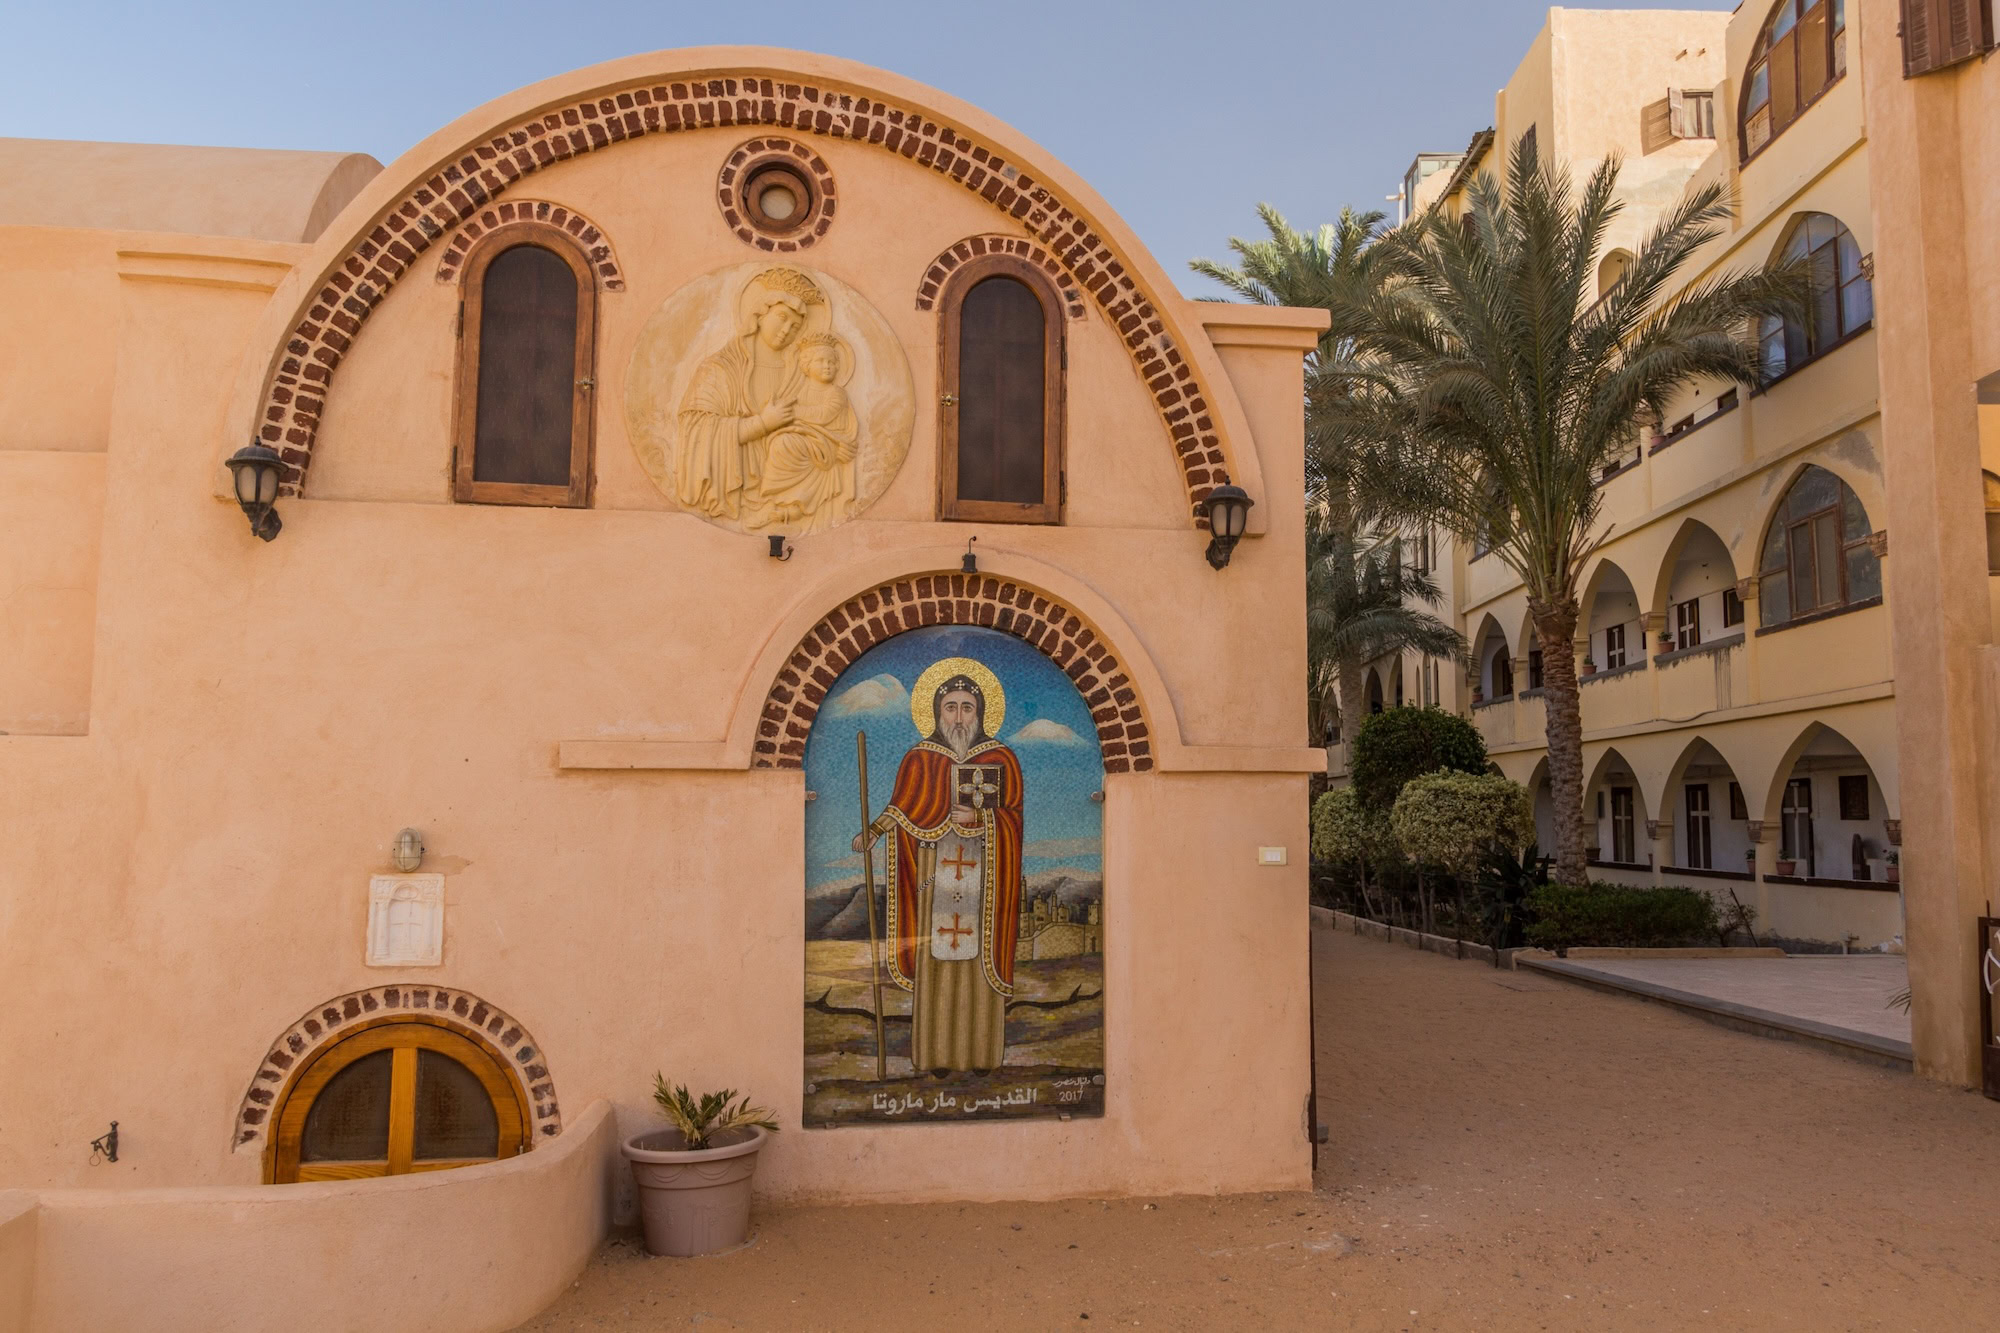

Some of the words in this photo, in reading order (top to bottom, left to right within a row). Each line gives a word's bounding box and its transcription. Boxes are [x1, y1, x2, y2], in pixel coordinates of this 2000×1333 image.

[873, 1092, 924, 1115] ماروتا
[927, 1091, 957, 1113] مار
[963, 1088, 1037, 1113] القديس
[1059, 1090, 1083, 1102] 2017
